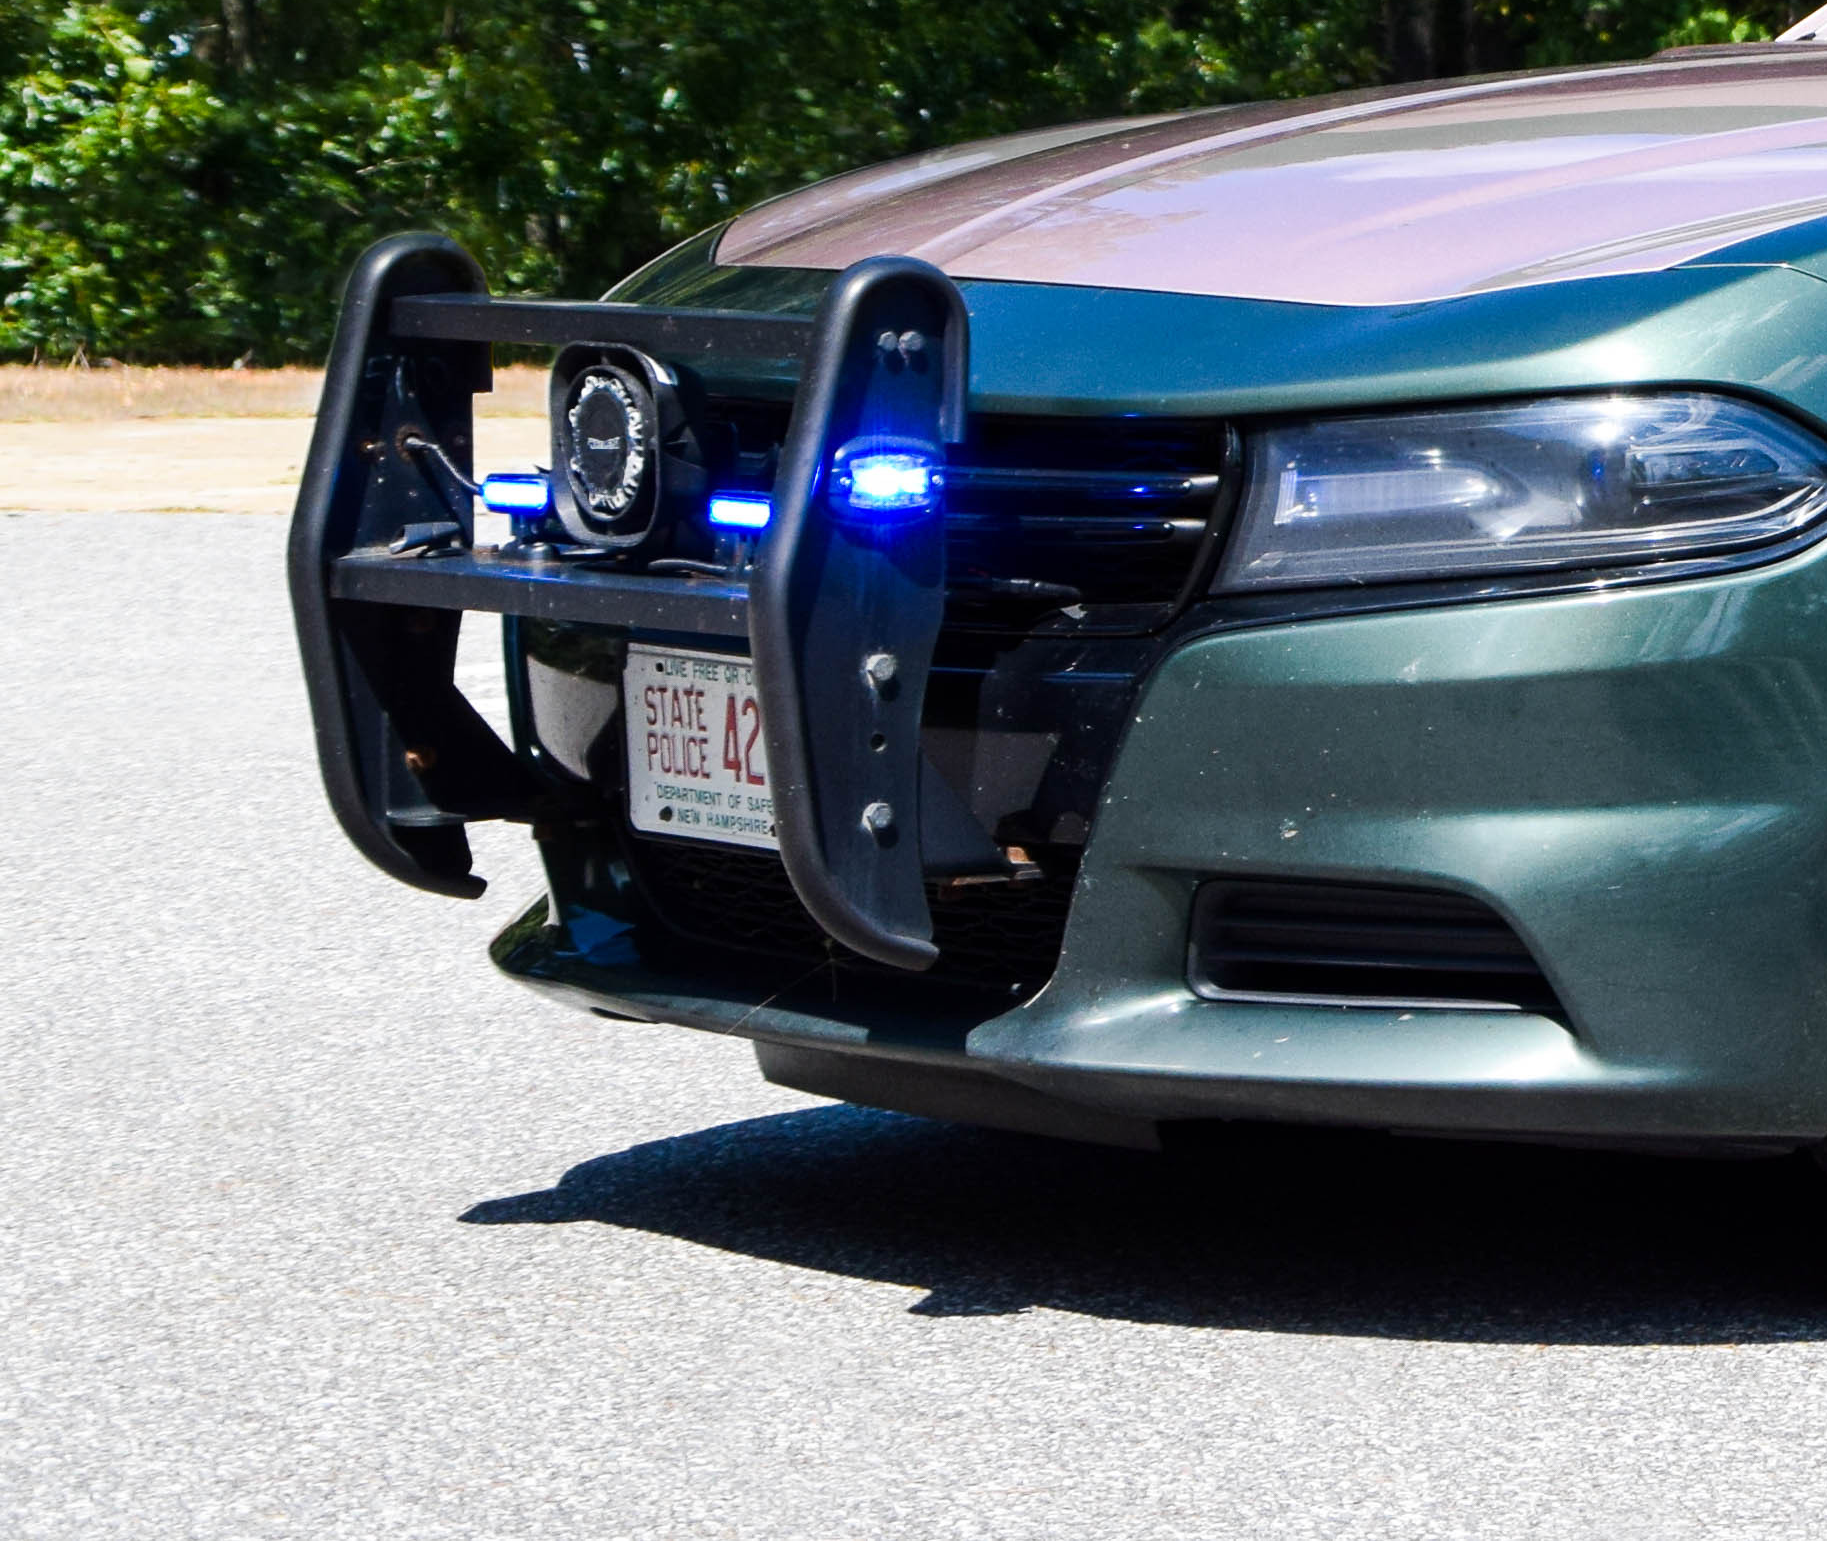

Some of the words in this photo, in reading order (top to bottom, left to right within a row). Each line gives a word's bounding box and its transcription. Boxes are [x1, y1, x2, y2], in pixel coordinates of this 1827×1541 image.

[664, 659, 687, 678] LIVE
[693, 661, 719, 682] FREE
[725, 665, 739, 683] OR
[644, 684, 707, 732] STATE
[647, 733, 711, 779] POLICE
[723, 693, 765, 786] 42
[656, 784, 722, 805] DEPARTMENT
[727, 794, 741, 809] OF
[747, 796, 775, 816] SAFE
[677, 808, 700, 824] NEW
[705, 812, 769, 835] HAMPSHIRE
